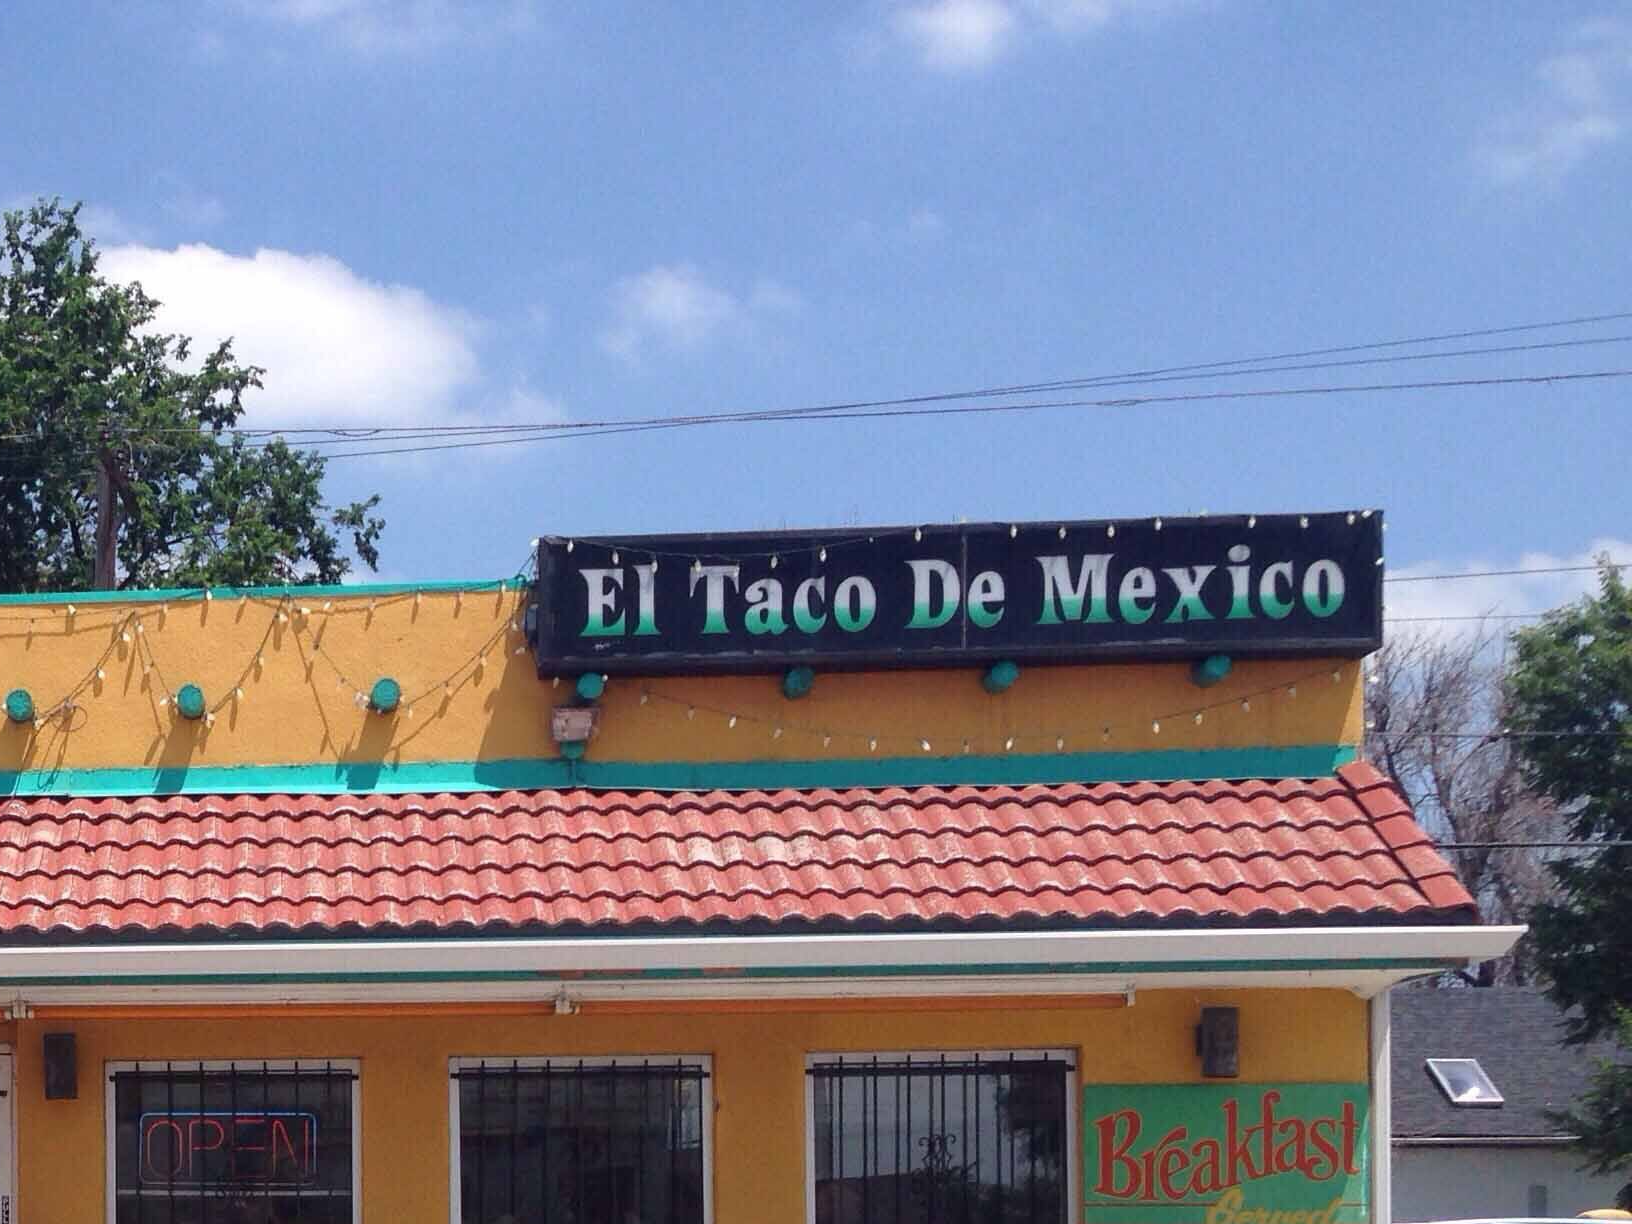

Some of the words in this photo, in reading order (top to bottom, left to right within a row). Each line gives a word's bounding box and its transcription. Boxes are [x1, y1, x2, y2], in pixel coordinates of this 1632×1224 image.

[578, 564, 662, 637] El
[689, 564, 878, 636] Taco
[904, 559, 1006, 629] De
[1034, 543, 1345, 625] Mexico
[146, 1119, 310, 1179] OPEN
[1093, 1089, 1361, 1200] Breakfast
